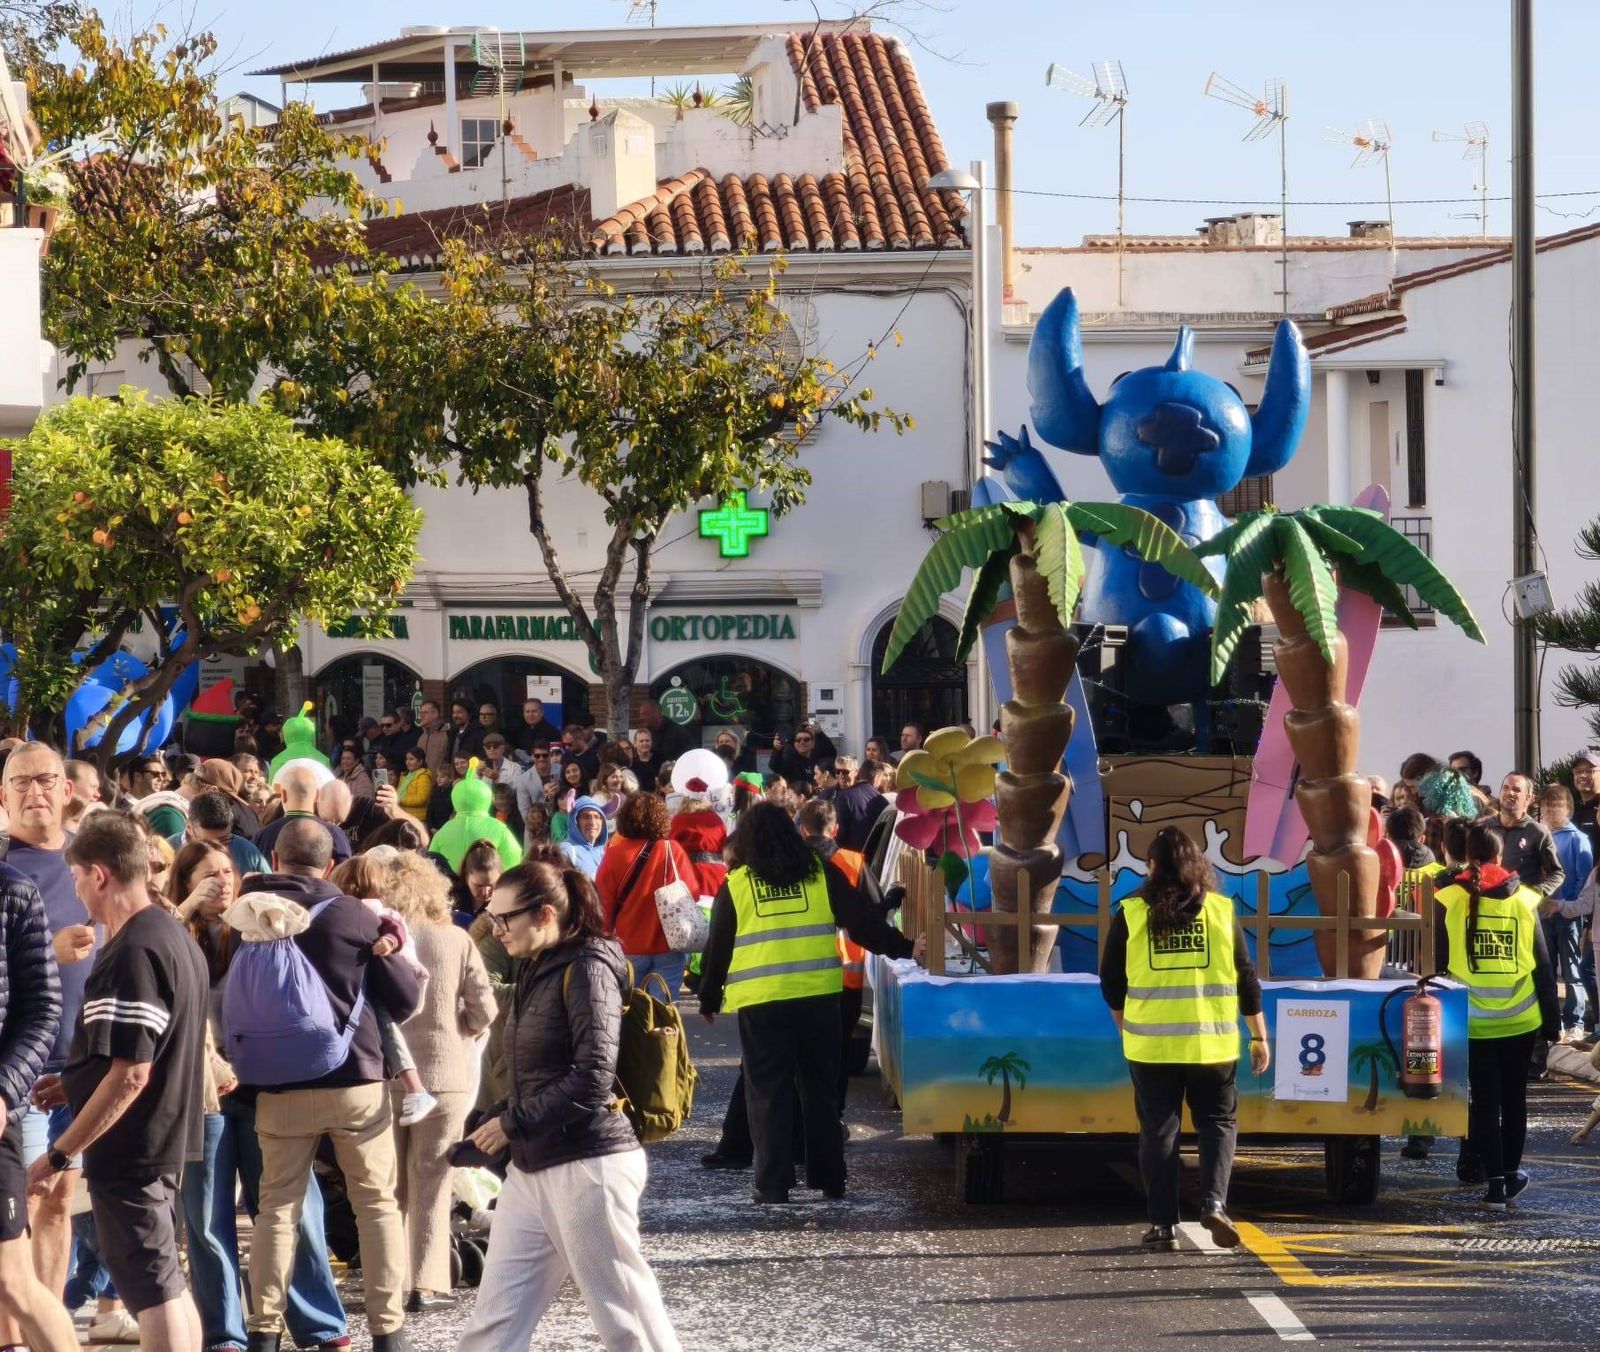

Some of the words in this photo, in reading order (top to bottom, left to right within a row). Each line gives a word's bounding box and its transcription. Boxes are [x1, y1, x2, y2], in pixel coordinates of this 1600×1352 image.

[651, 614, 796, 641] ORTOPEDIA
[667, 703, 690, 718] 12h
[1287, 1008, 1338, 1018] CARROZA
[1298, 1033, 1326, 1068] 8
